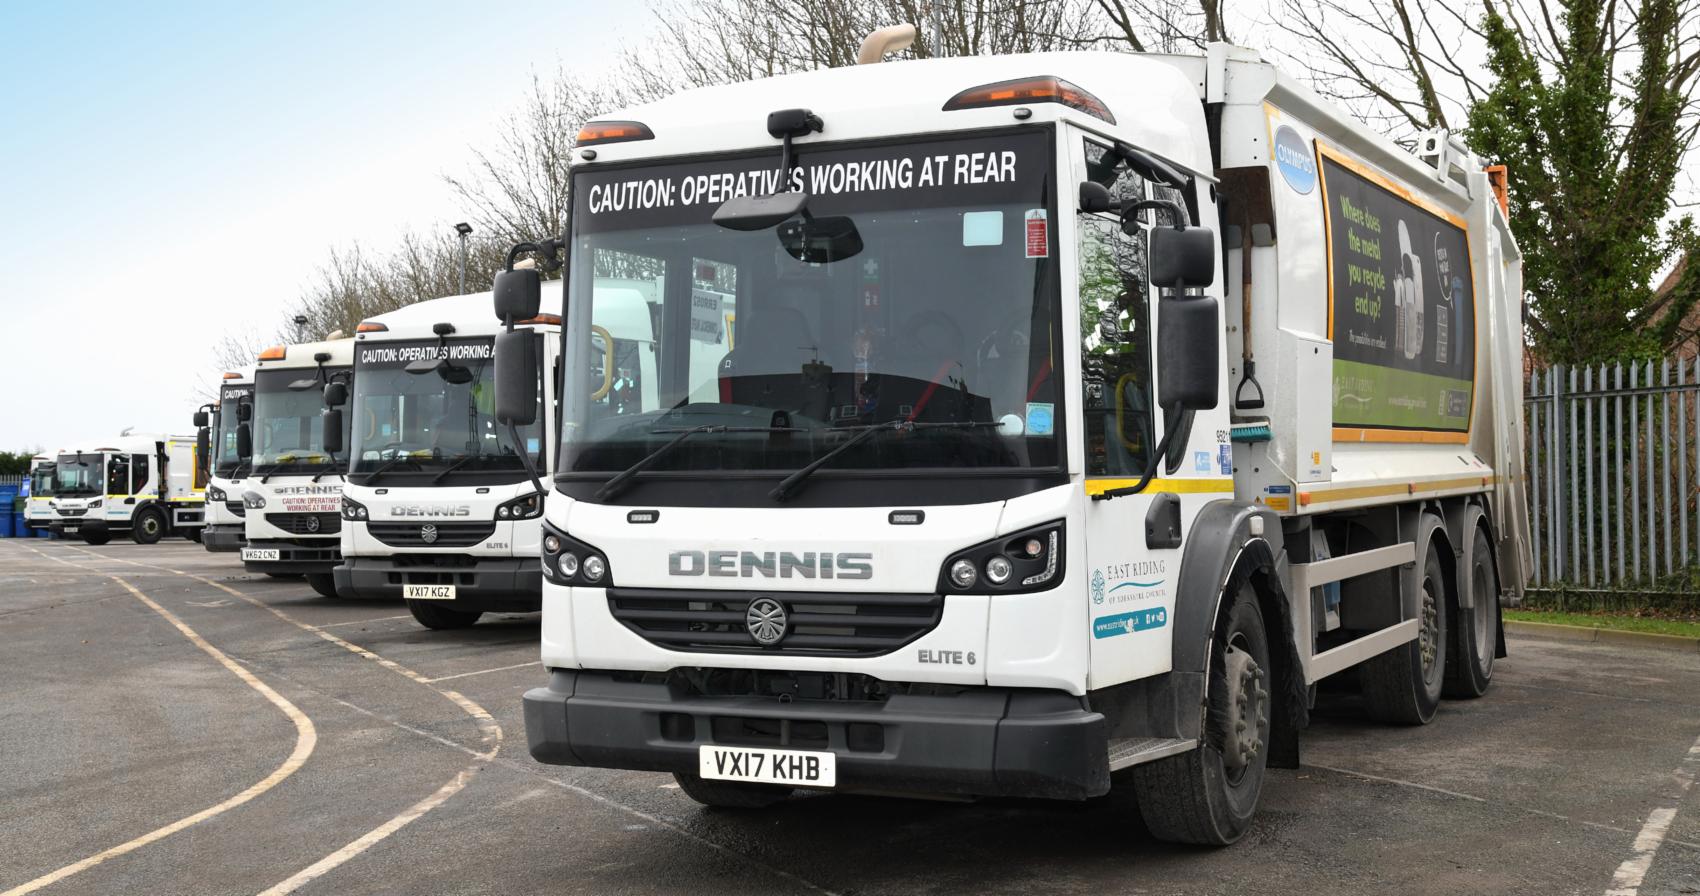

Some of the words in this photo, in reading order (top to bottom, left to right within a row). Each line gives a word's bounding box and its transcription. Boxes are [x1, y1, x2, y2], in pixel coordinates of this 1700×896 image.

[1278, 144, 1313, 174] OLYMPUS
[589, 178, 676, 214] CAUTION:
[810, 157, 914, 195] WORKING
[918, 155, 949, 188] AT
[953, 151, 1017, 185] REAR
[1340, 194, 1364, 226] Where
[1365, 206, 1381, 234] does
[1348, 227, 1361, 254] the
[1361, 238, 1381, 261] metal
[1348, 264, 1361, 287] you
[1362, 267, 1386, 294] recycle
[1354, 291, 1369, 315] end
[1369, 295, 1382, 323] up?
[361, 348, 398, 364] CAUTION:
[450, 344, 490, 359] WORKING
[284, 485, 343, 495] DENNIS
[307, 496, 341, 504] OPERATIVES
[391, 505, 471, 517] DENNIS
[245, 550, 261, 559] VK62
[263, 550, 277, 559] CNZ
[668, 550, 874, 580] DENNIS
[1107, 563, 1130, 580] EAST
[1132, 559, 1166, 577] RIDING
[409, 586, 429, 597] VX17
[431, 586, 450, 598] KGZ
[917, 649, 964, 664] ELITE
[966, 650, 977, 665] 6
[714, 750, 766, 777] VX17
[772, 754, 820, 781] KHB
